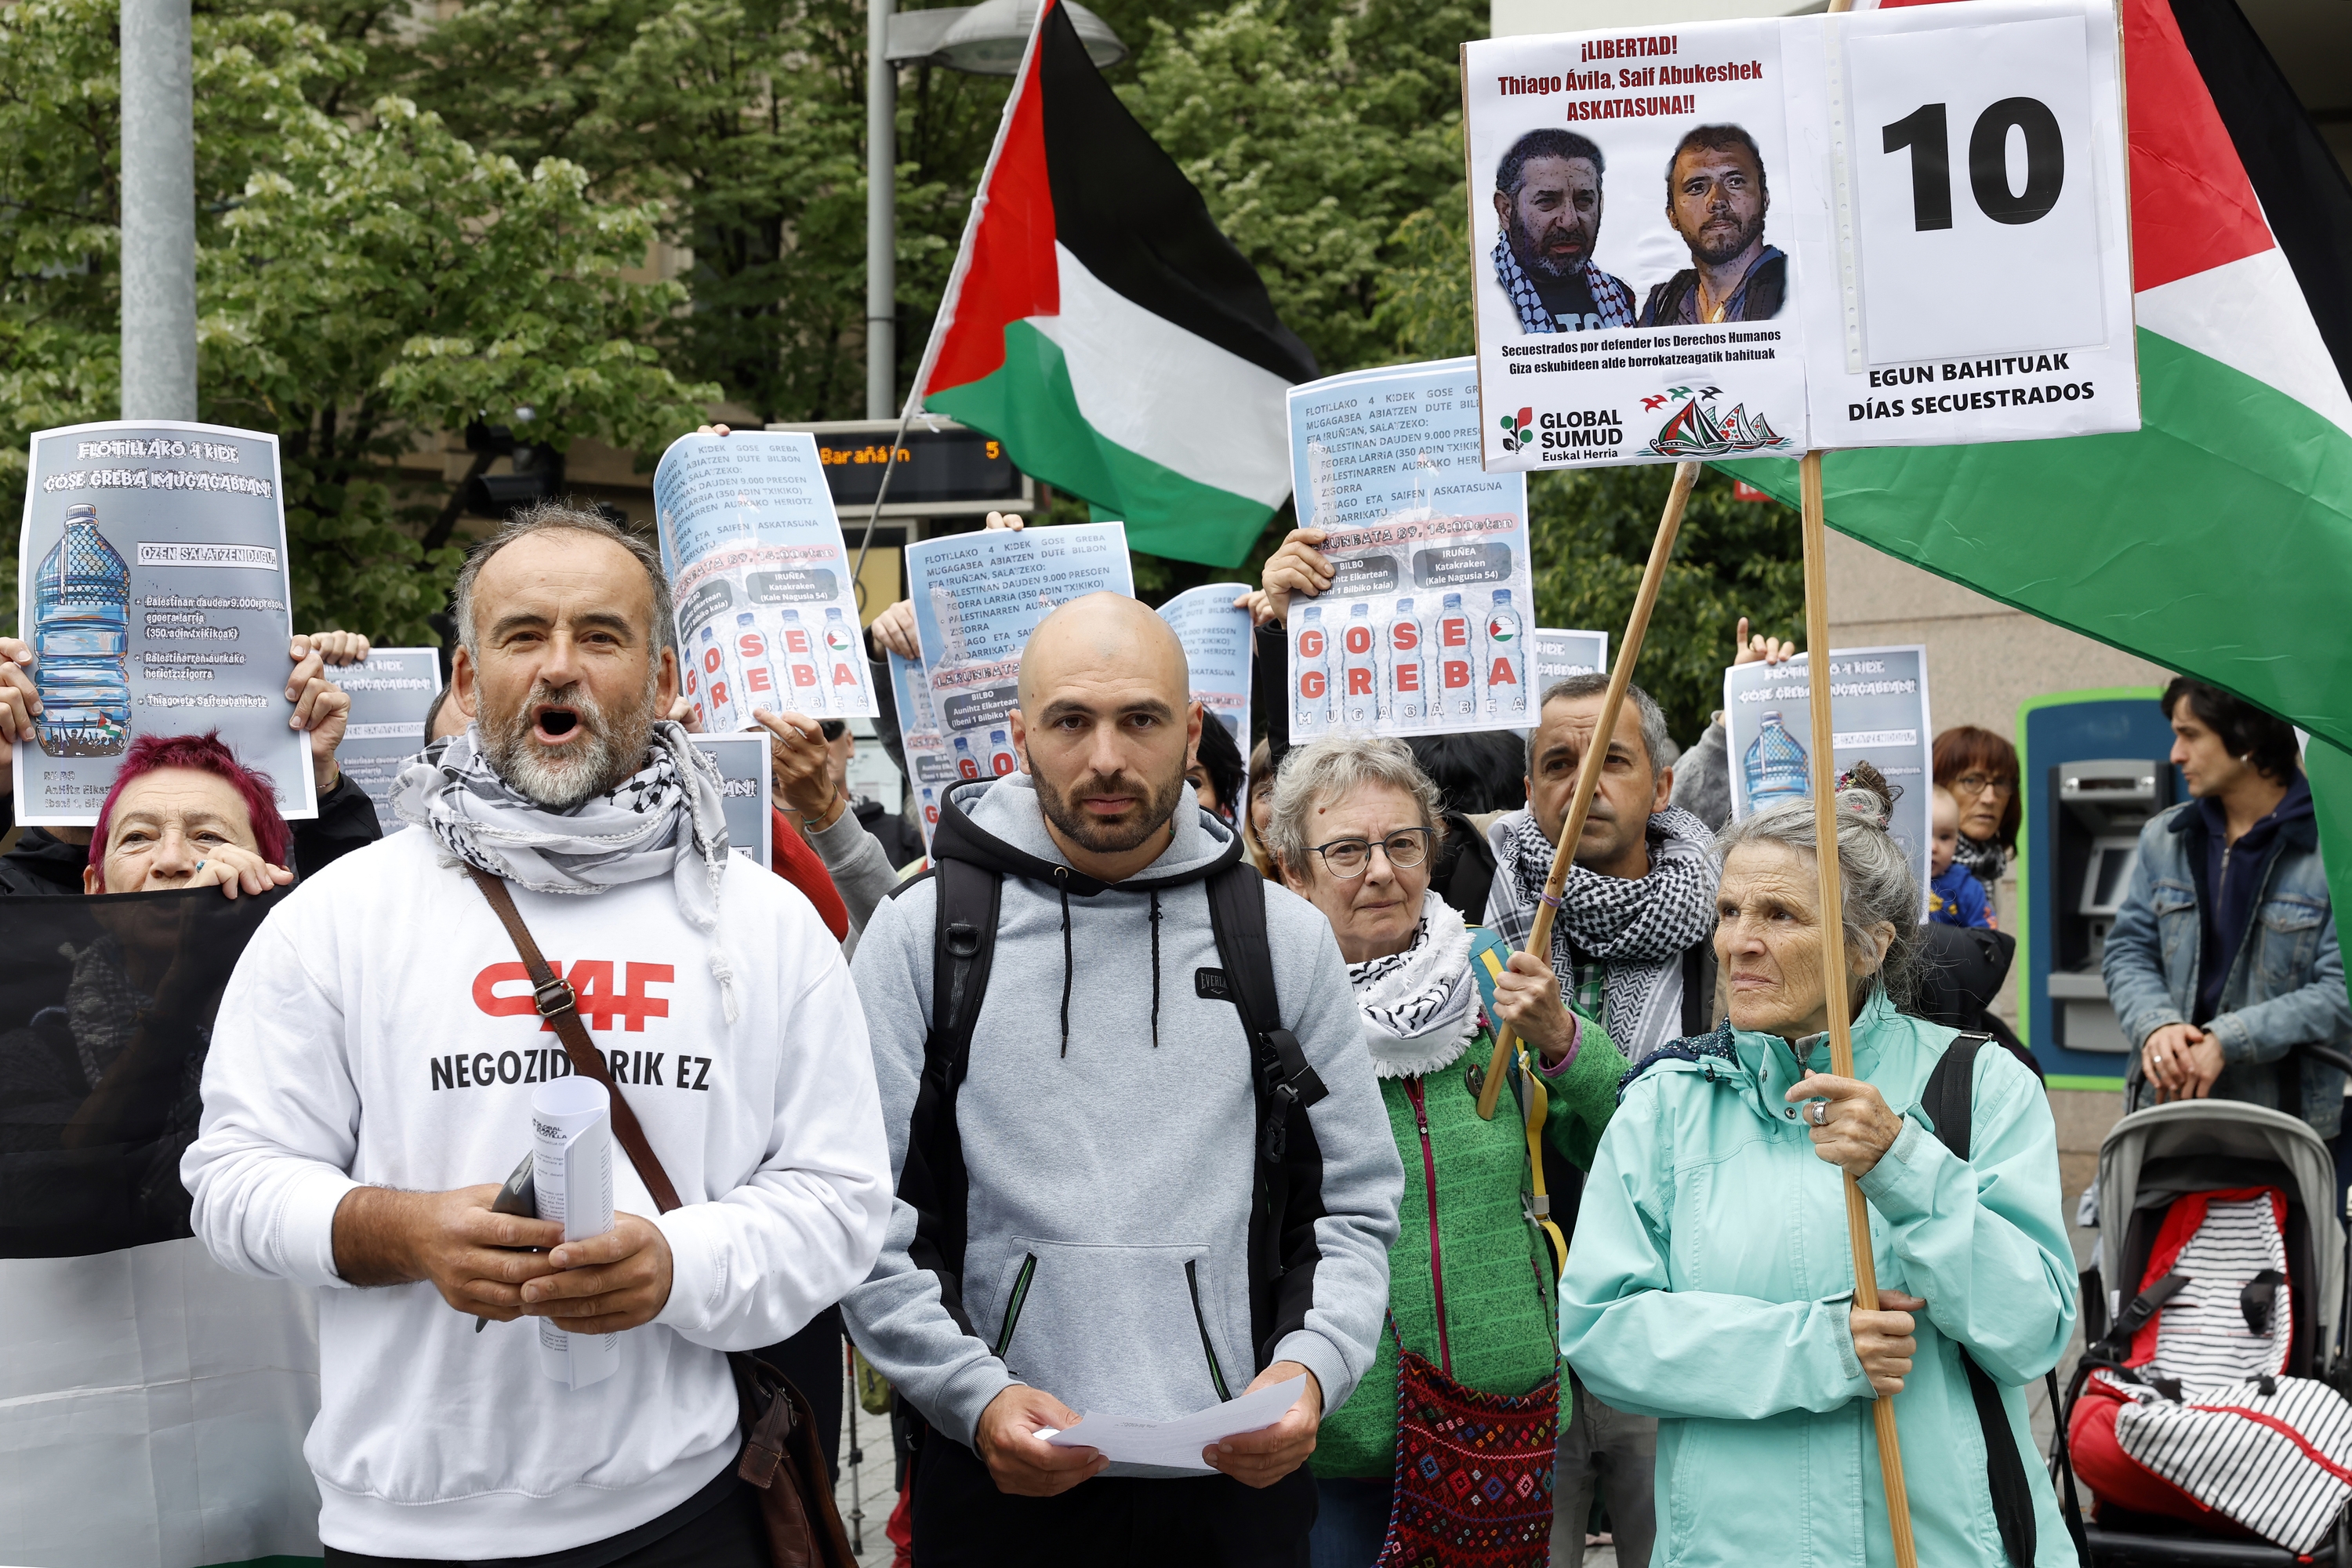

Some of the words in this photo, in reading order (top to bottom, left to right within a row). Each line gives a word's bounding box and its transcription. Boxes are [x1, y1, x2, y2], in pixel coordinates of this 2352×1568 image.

[1581, 35, 1678, 62] ¡LIBERTAD!
[1498, 76, 1561, 96] Thiago
[1566, 69, 1615, 91] Ávila,
[1619, 67, 1655, 87] Saif
[1659, 60, 1763, 85] Abukeshek
[1567, 95, 1695, 121] ASKATASUNA!!
[1882, 96, 2064, 231] 10
[1502, 343, 1577, 357] Secuestrados
[1581, 343, 1599, 354] por
[1601, 339, 1652, 352] defender
[1654, 337, 1671, 348] los
[1673, 334, 1726, 347] Derechos
[1728, 331, 1781, 343] Humanos
[1509, 363, 1532, 375] Giza
[1534, 358, 1599, 373] eskubideen
[1602, 357, 1626, 369] alde
[1628, 351, 1723, 368] borrokatzeagatik
[1725, 348, 1775, 361] bahituak
[1870, 365, 1934, 388] EGUN
[1943, 353, 2070, 381] BAHITUAK
[1305, 399, 1357, 417] FLOTILLAKO
[1386, 392, 1415, 403] KIDEK
[1427, 387, 1453, 398] GOSE
[1849, 397, 1904, 421] DÍAS
[1911, 383, 2095, 416] SECUESTRADOS
[1306, 414, 1362, 430] MUGAGABEA
[1369, 406, 1417, 419] ABIATZEN
[1425, 402, 1451, 412] DUTE
[1541, 409, 1622, 429] GLOBAL
[1307, 434, 1322, 444] ETA
[1323, 426, 1367, 441] IRUÑEAN,
[1370, 419, 1428, 433] SALATZEKO:
[1541, 429, 1623, 448] SUMUD
[78, 438, 188, 460] FLOTILLAKO
[190, 441, 201, 459] 4
[204, 442, 238, 464] KIDE
[699, 445, 726, 454] KIDEK
[820, 445, 910, 465] Barañáin
[986, 441, 999, 459] 5
[1321, 438, 1377, 456] PALESTINAN
[1380, 434, 1421, 445] DAUDEN
[1425, 431, 1450, 440] 9.000
[1543, 450, 1580, 461] Euskal
[1584, 448, 1618, 459] Herria
[686, 456, 729, 470] ABIATZEN
[1321, 456, 1356, 469] EGOERA
[1359, 452, 1393, 463] LARRIA
[1396, 448, 1416, 459] (350
[1418, 445, 1445, 456] ADIN
[1321, 464, 1396, 483] PALESTINARREN
[1402, 459, 1450, 471] AURKAKO
[44, 470, 86, 493] GOSE
[89, 469, 149, 489] GREBA
[151, 470, 273, 499] MUGAGABEAN!
[699, 478, 738, 490] DAUDEN
[1322, 484, 1362, 497] ZIGORRA
[724, 499, 768, 508] AURKAKO
[1323, 499, 1357, 511] THIAGO
[1366, 495, 1383, 504] ETA
[1391, 489, 1425, 501] SAIFEN
[1434, 481, 1502, 496] ASKATASUNA
[717, 524, 750, 533] SAIFEN
[758, 521, 818, 529] ASKATASUNA
[1323, 508, 1388, 524] ALDARRIKATU
[1397, 526, 1422, 539] 09,
[1427, 517, 1512, 535] 14:00etan
[141, 547, 177, 560] OZEN
[180, 548, 245, 561] SALATZEN
[246, 549, 276, 564] DUGU:
[925, 549, 978, 564] FLOTILLAKO
[1004, 541, 1031, 551] KIDEK
[927, 561, 983, 576] MUGAGABEA
[990, 553, 1034, 566] ABIATZEN
[1041, 549, 1065, 557] DUTE
[1073, 545, 1107, 554] BILBON
[1443, 548, 1475, 557] IRUÑEA
[928, 580, 944, 589] ETA
[946, 572, 989, 586] IRUÑEAN,
[992, 564, 1045, 578] SALATZEKO:
[1340, 561, 1363, 571] BILBO
[1350, 570, 1388, 582] Elkartean
[1435, 561, 1485, 572] Katakraken
[945, 584, 1000, 598] PALESTINAN
[1003, 577, 1040, 590] DAUDEN
[1043, 573, 1066, 583] 9.000
[1069, 567, 1110, 579] PRESOEN
[1343, 584, 1372, 594] Bilbiko
[1373, 581, 1393, 591] kaia)
[1425, 576, 1446, 586] (Kale
[1448, 572, 1482, 583] Nagusia
[1484, 571, 1498, 579] 54)
[144, 595, 196, 608] Palestinan
[196, 597, 228, 608] dauden
[230, 597, 256, 608] 9.000
[782, 593, 814, 601] Nagusia
[985, 593, 1016, 605] LARRIA
[1018, 590, 1036, 601] (350
[1039, 585, 1062, 595] ADIN
[1064, 580, 1104, 592] TXIKIKO)
[144, 612, 178, 624] egoera
[179, 612, 206, 623] larria
[949, 605, 1019, 623] PALESTINARREN
[1025, 597, 1069, 612] AURKAKO
[144, 626, 166, 640] (350
[169, 626, 189, 640] adin
[191, 626, 239, 641] txikikoak)
[950, 622, 989, 637] ZIGORRA
[1300, 619, 1465, 658] GOSE
[952, 637, 985, 649] THIAGO
[994, 633, 1010, 641] ETA
[143, 651, 206, 664] Palestinarren
[209, 652, 246, 664] aurkako
[143, 667, 177, 680] heriotz
[180, 669, 214, 681] zigorra
[936, 663, 1019, 687] LARUNBATA
[1301, 658, 1516, 699] GREBA
[971, 691, 994, 701] BILBO
[1831, 680, 1916, 696] UGAGABEAN!
[146, 694, 177, 707] Thiago
[180, 695, 194, 706] eta
[196, 694, 226, 706] Saifen
[228, 695, 268, 707] bahiketa
[953, 705, 980, 715] Aunihtz
[982, 699, 1018, 710] Elkartean
[1298, 698, 1525, 724] MUGAGABEA
[952, 717, 971, 728] (Ibeni
[978, 713, 1004, 722] Bilbiko
[472, 960, 674, 1032] CAF
[677, 1055, 712, 1091] EZ
